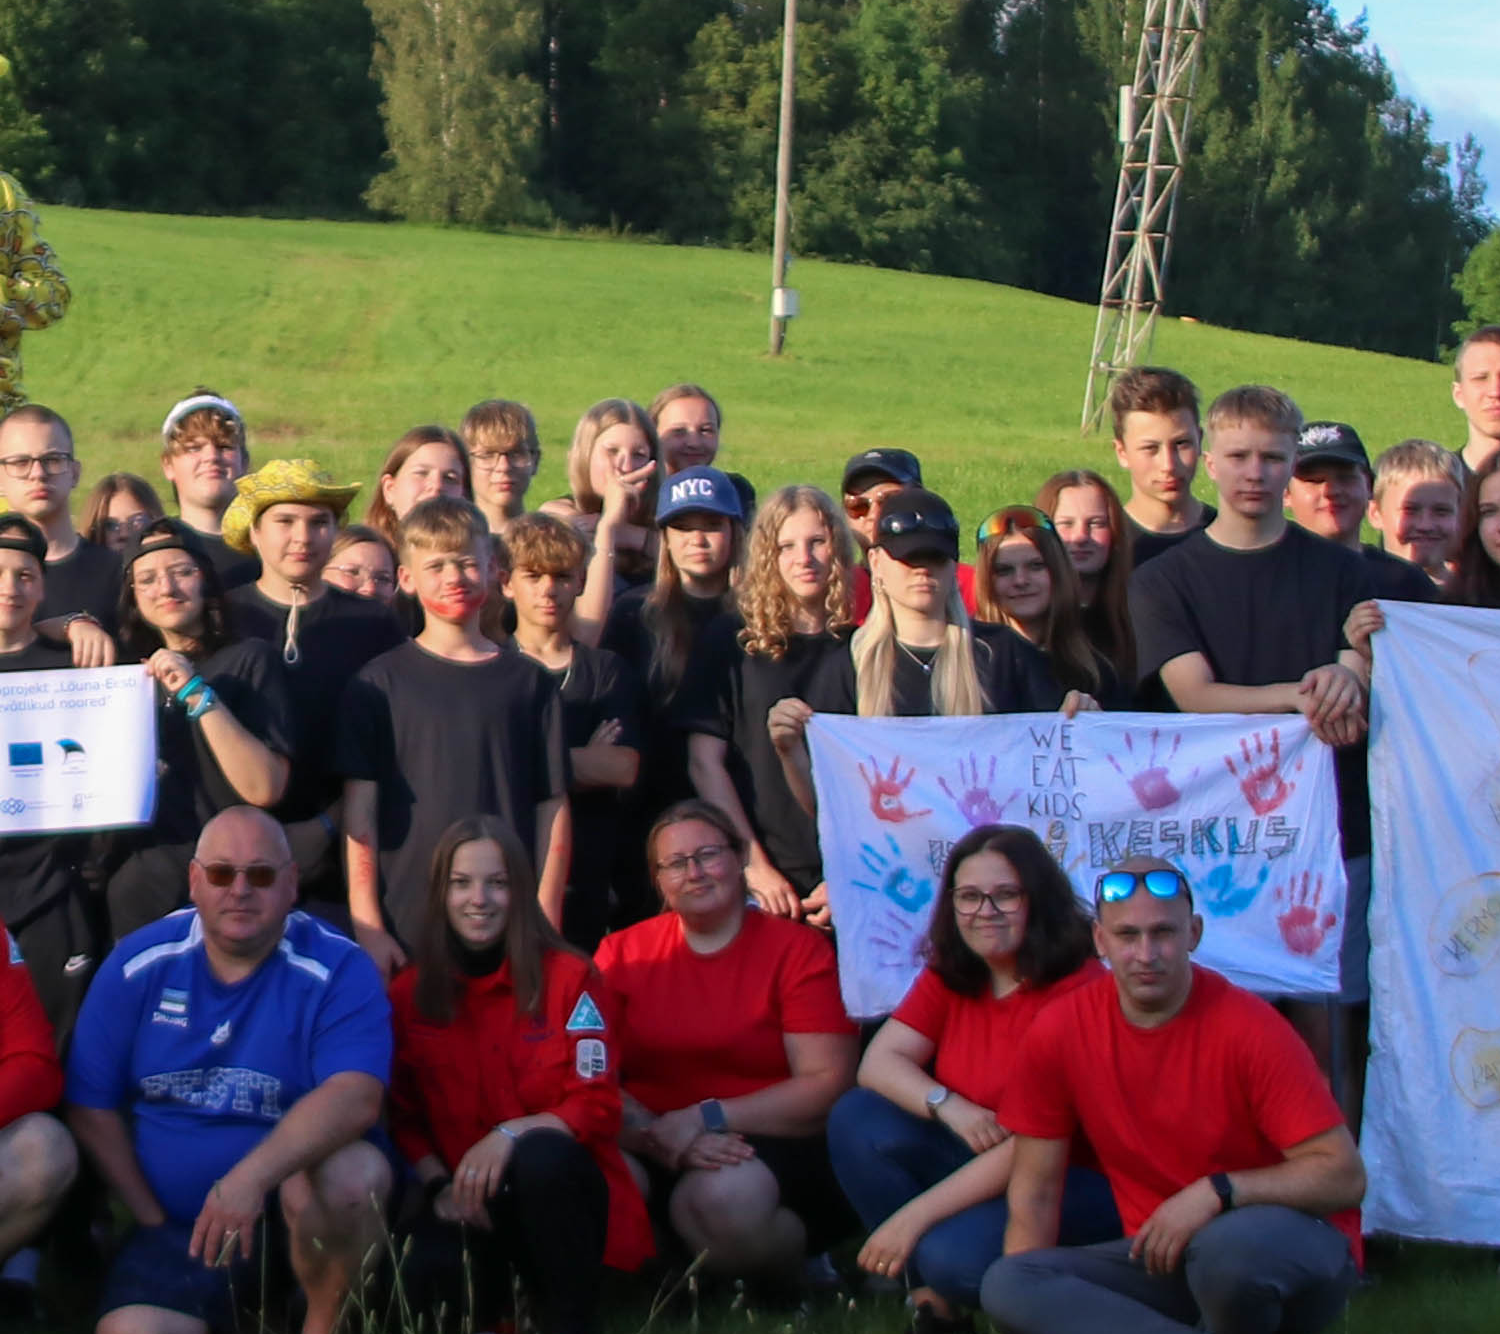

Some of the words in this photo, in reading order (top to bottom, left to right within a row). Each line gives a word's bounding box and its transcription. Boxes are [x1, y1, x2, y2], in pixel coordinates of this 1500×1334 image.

[671, 478, 713, 503] NYC
[1028, 724, 1074, 752] WE
[1031, 755, 1088, 788] EAT
[1088, 815, 1302, 869] KESKUS
